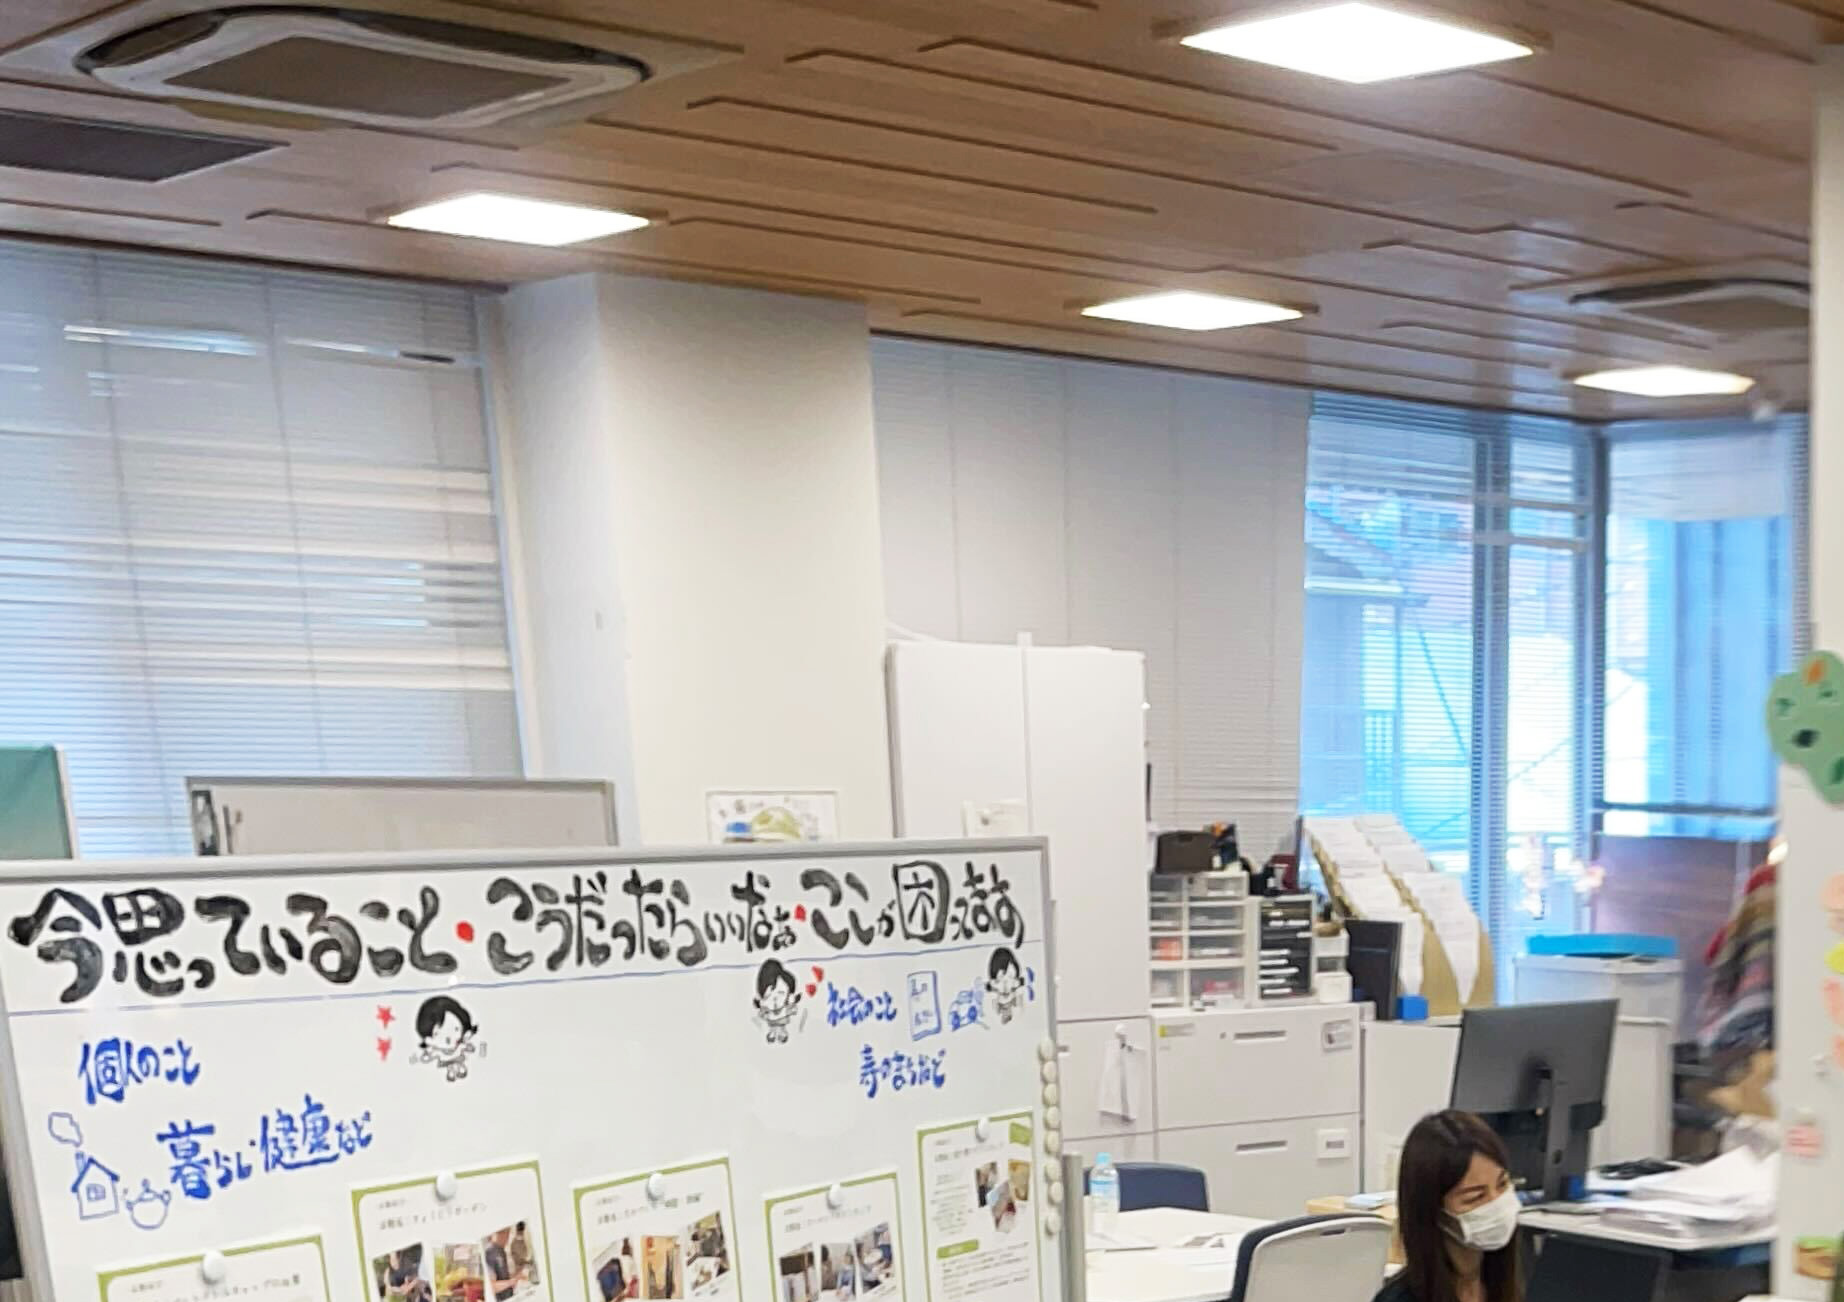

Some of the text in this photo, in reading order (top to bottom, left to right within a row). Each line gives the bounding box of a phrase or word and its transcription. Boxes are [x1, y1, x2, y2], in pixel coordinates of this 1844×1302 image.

[78, 1037, 202, 1106] 個人のこと
[156, 1093, 373, 1199] 暮らし・健康など
